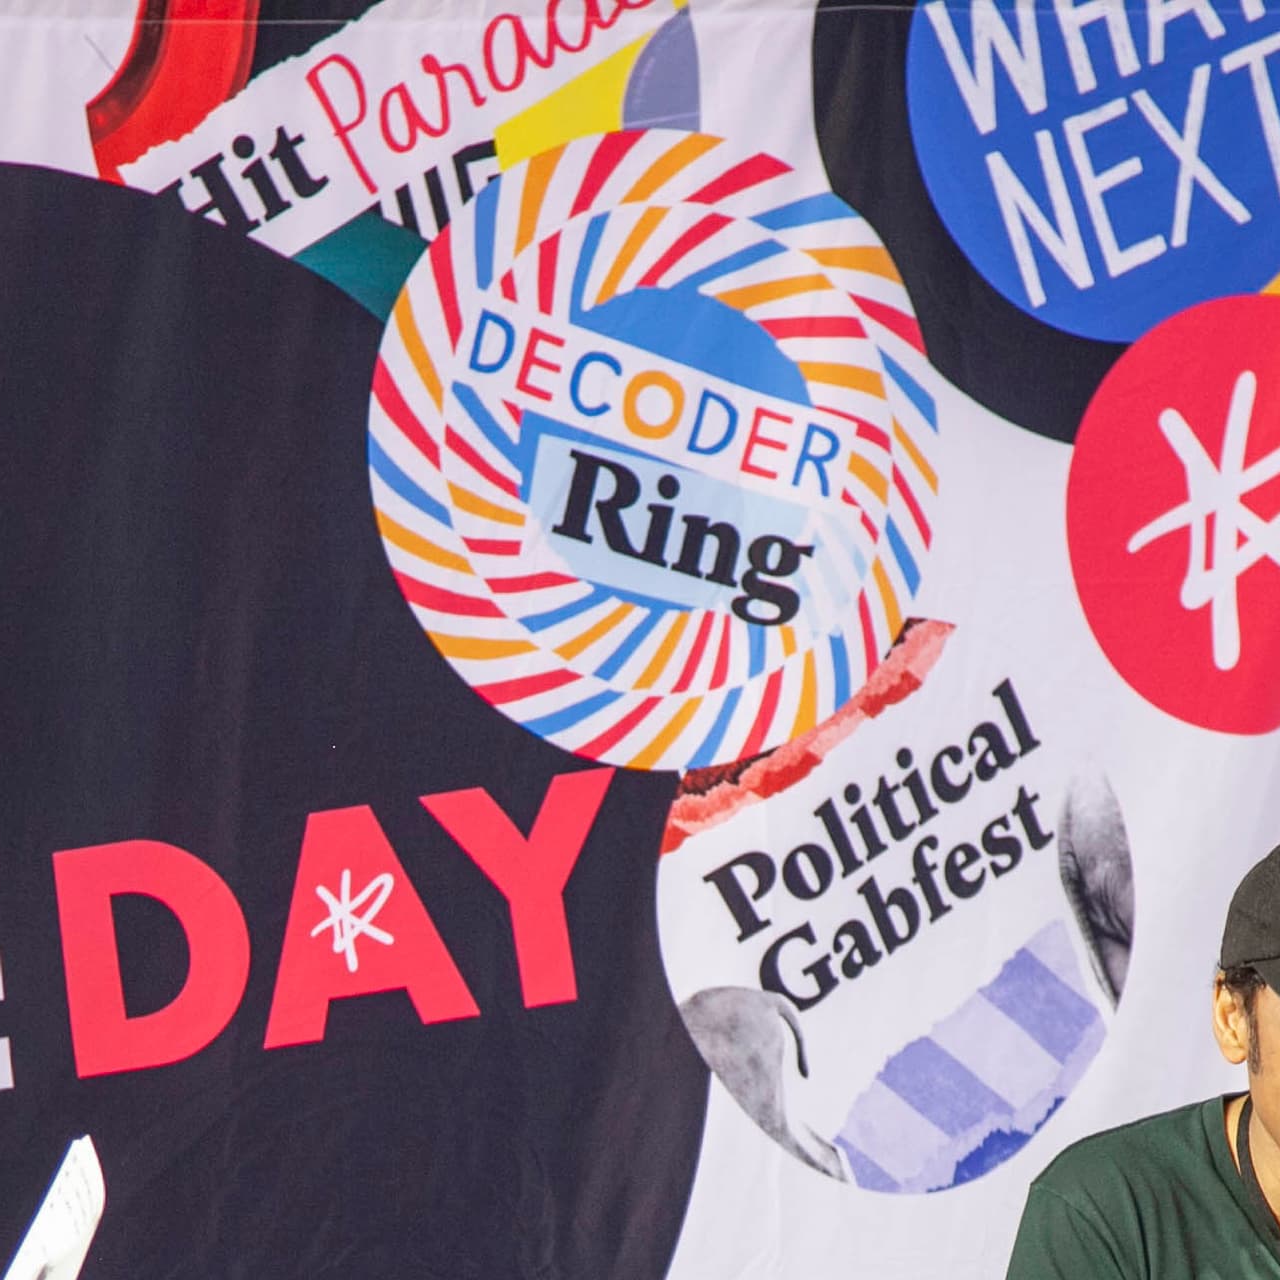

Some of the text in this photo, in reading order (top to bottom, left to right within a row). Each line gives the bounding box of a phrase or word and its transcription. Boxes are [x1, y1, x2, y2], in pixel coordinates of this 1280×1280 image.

[306, 0, 656, 195] Para
[925, 0, 1266, 135] WH
[469, 309, 840, 498] DECODER
[552, 449, 814, 625] Ring
[703, 677, 1041, 943] Political
[759, 785, 1054, 1012] Gabfest
[52, 767, 616, 1078] DAY
